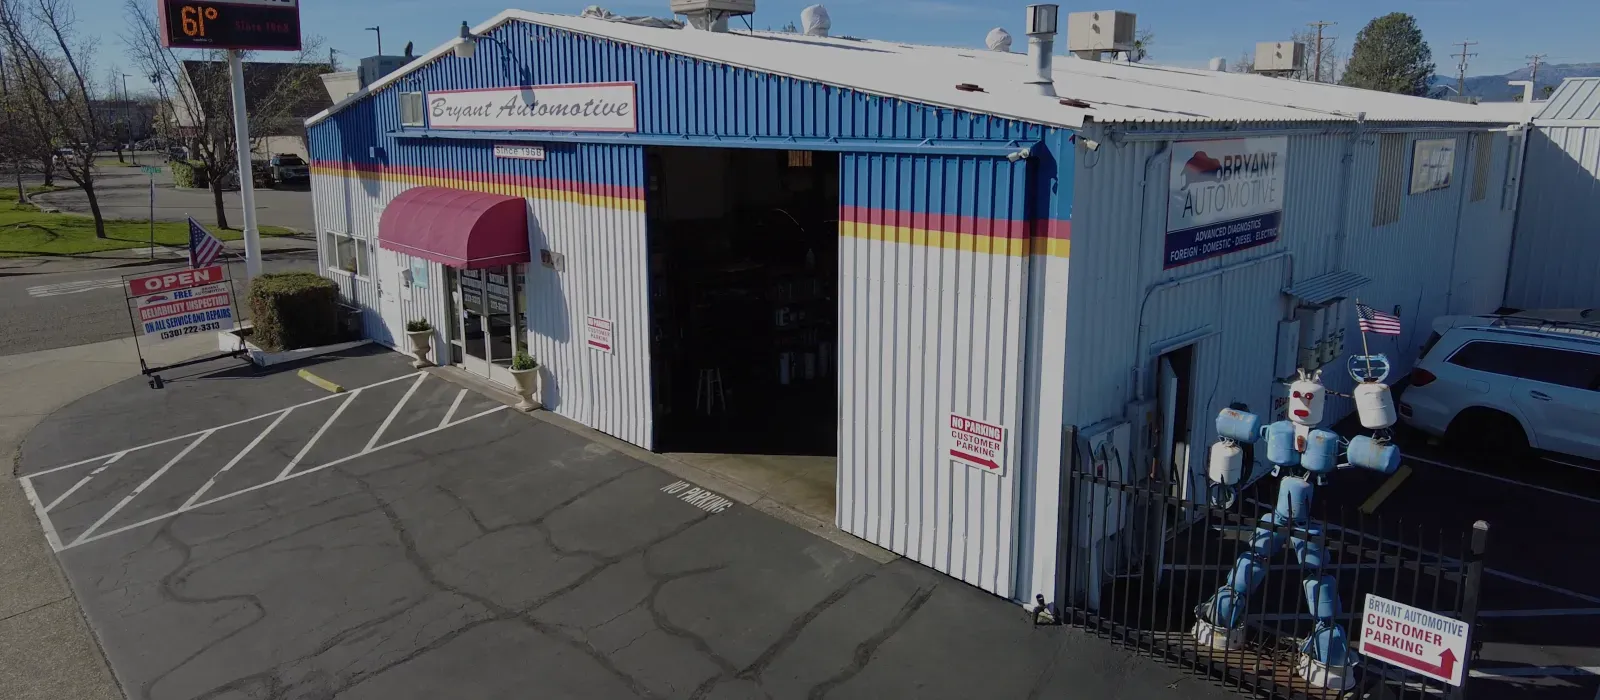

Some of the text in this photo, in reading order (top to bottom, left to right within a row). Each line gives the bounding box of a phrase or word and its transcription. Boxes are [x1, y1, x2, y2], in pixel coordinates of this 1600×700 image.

[430, 94, 631, 121] Bryant Automotive
[496, 146, 542, 157] Since 1968
[1223, 152, 1278, 180] BRYANT
[1182, 178, 1277, 218] AUTOMOTIVE
[1195, 219, 1262, 242] ADVANCED DIAGNOSTICS
[1170, 228, 1277, 262] FOREIGN DOMESTIC DIESEL ELECTRIC
[145, 270, 210, 289] OPEN
[142, 295, 228, 319] RELIABILITY INSPECTION
[173, 290, 193, 300] FREE
[145, 307, 232, 333] ON ALL SERVICE AND REPAIRS
[161, 321, 220, 340] (530) 222-3313
[952, 416, 1000, 441] NO PARKING
[952, 431, 1000, 450] CUSTOMER
[956, 440, 994, 458] PARKING
[660, 480, 734, 513] NO PARKING
[1367, 613, 1442, 647] CUSTOMER
[1368, 598, 1463, 637] BRYANT AUTOMOTIVE
[1365, 627, 1423, 656] PARKING
